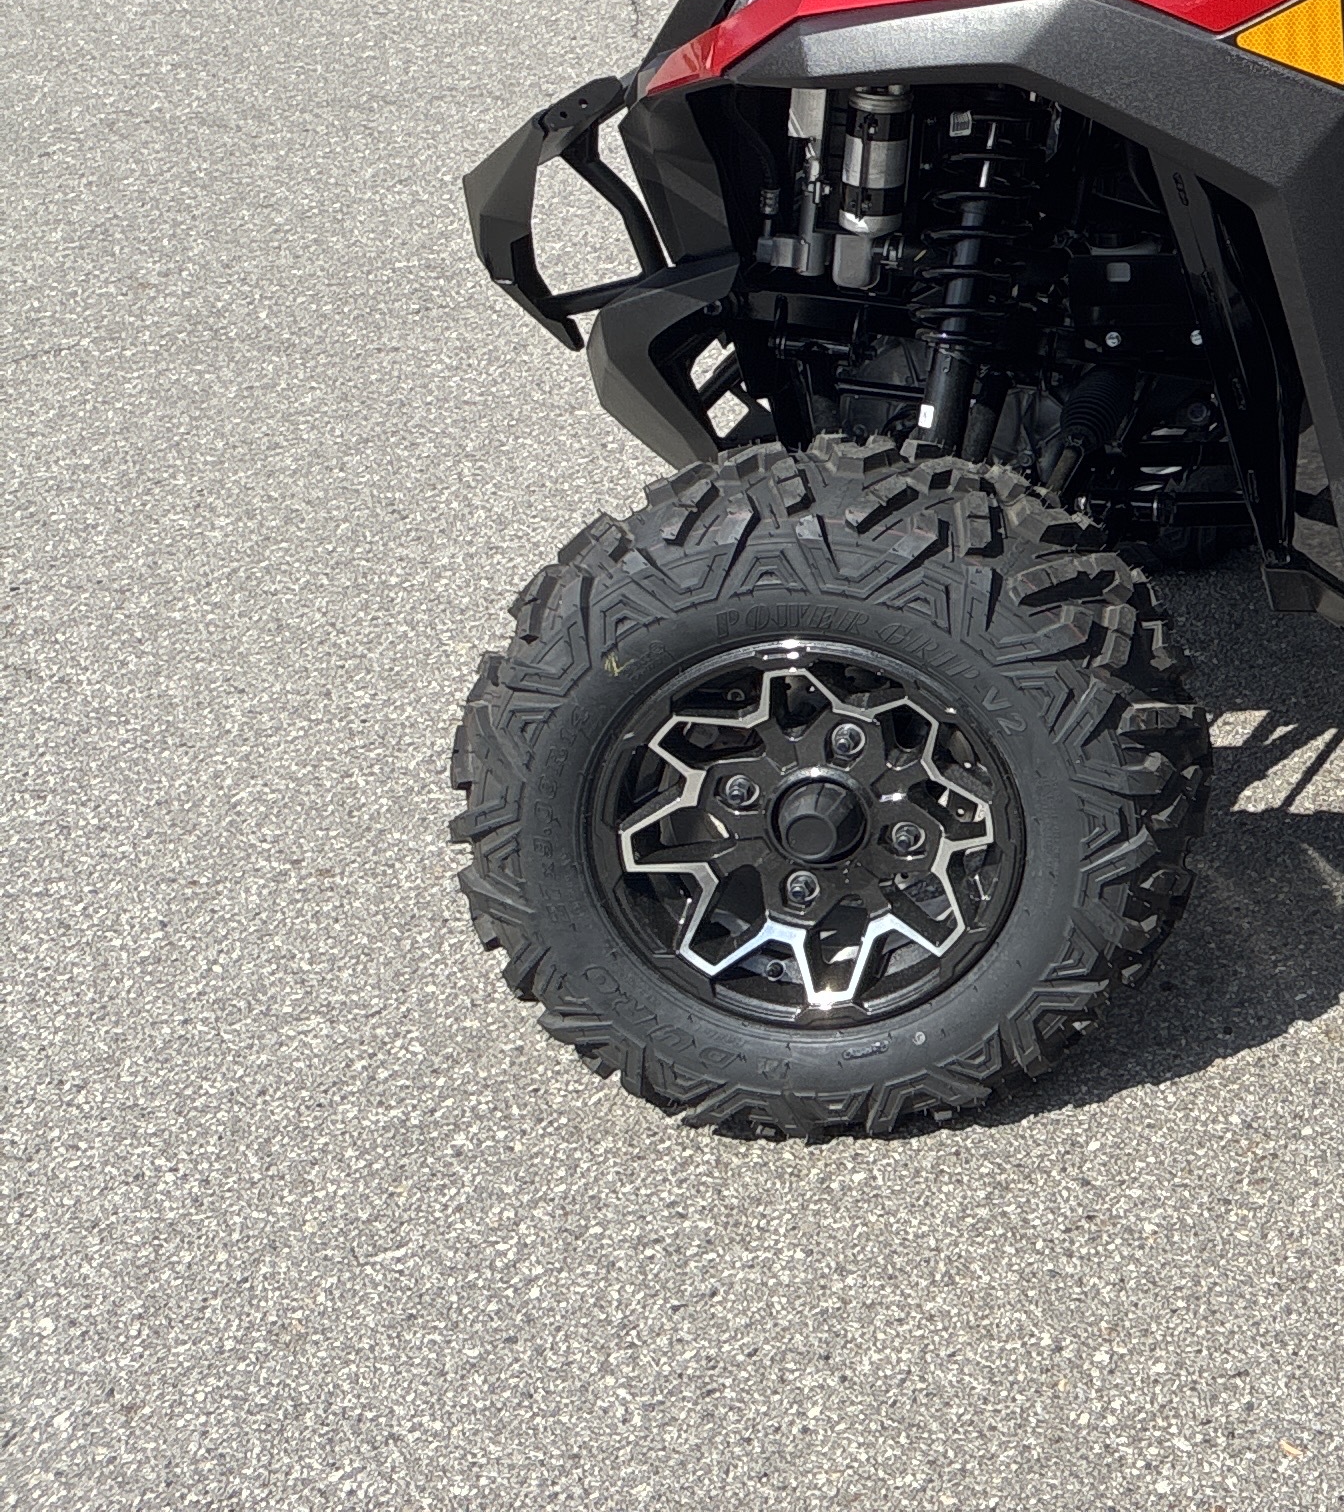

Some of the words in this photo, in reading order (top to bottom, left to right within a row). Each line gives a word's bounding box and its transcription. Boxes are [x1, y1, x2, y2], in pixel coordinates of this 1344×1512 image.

[715, 601, 871, 638] POWER
[875, 622, 981, 680] GRIP
[982, 689, 1028, 737] V2
